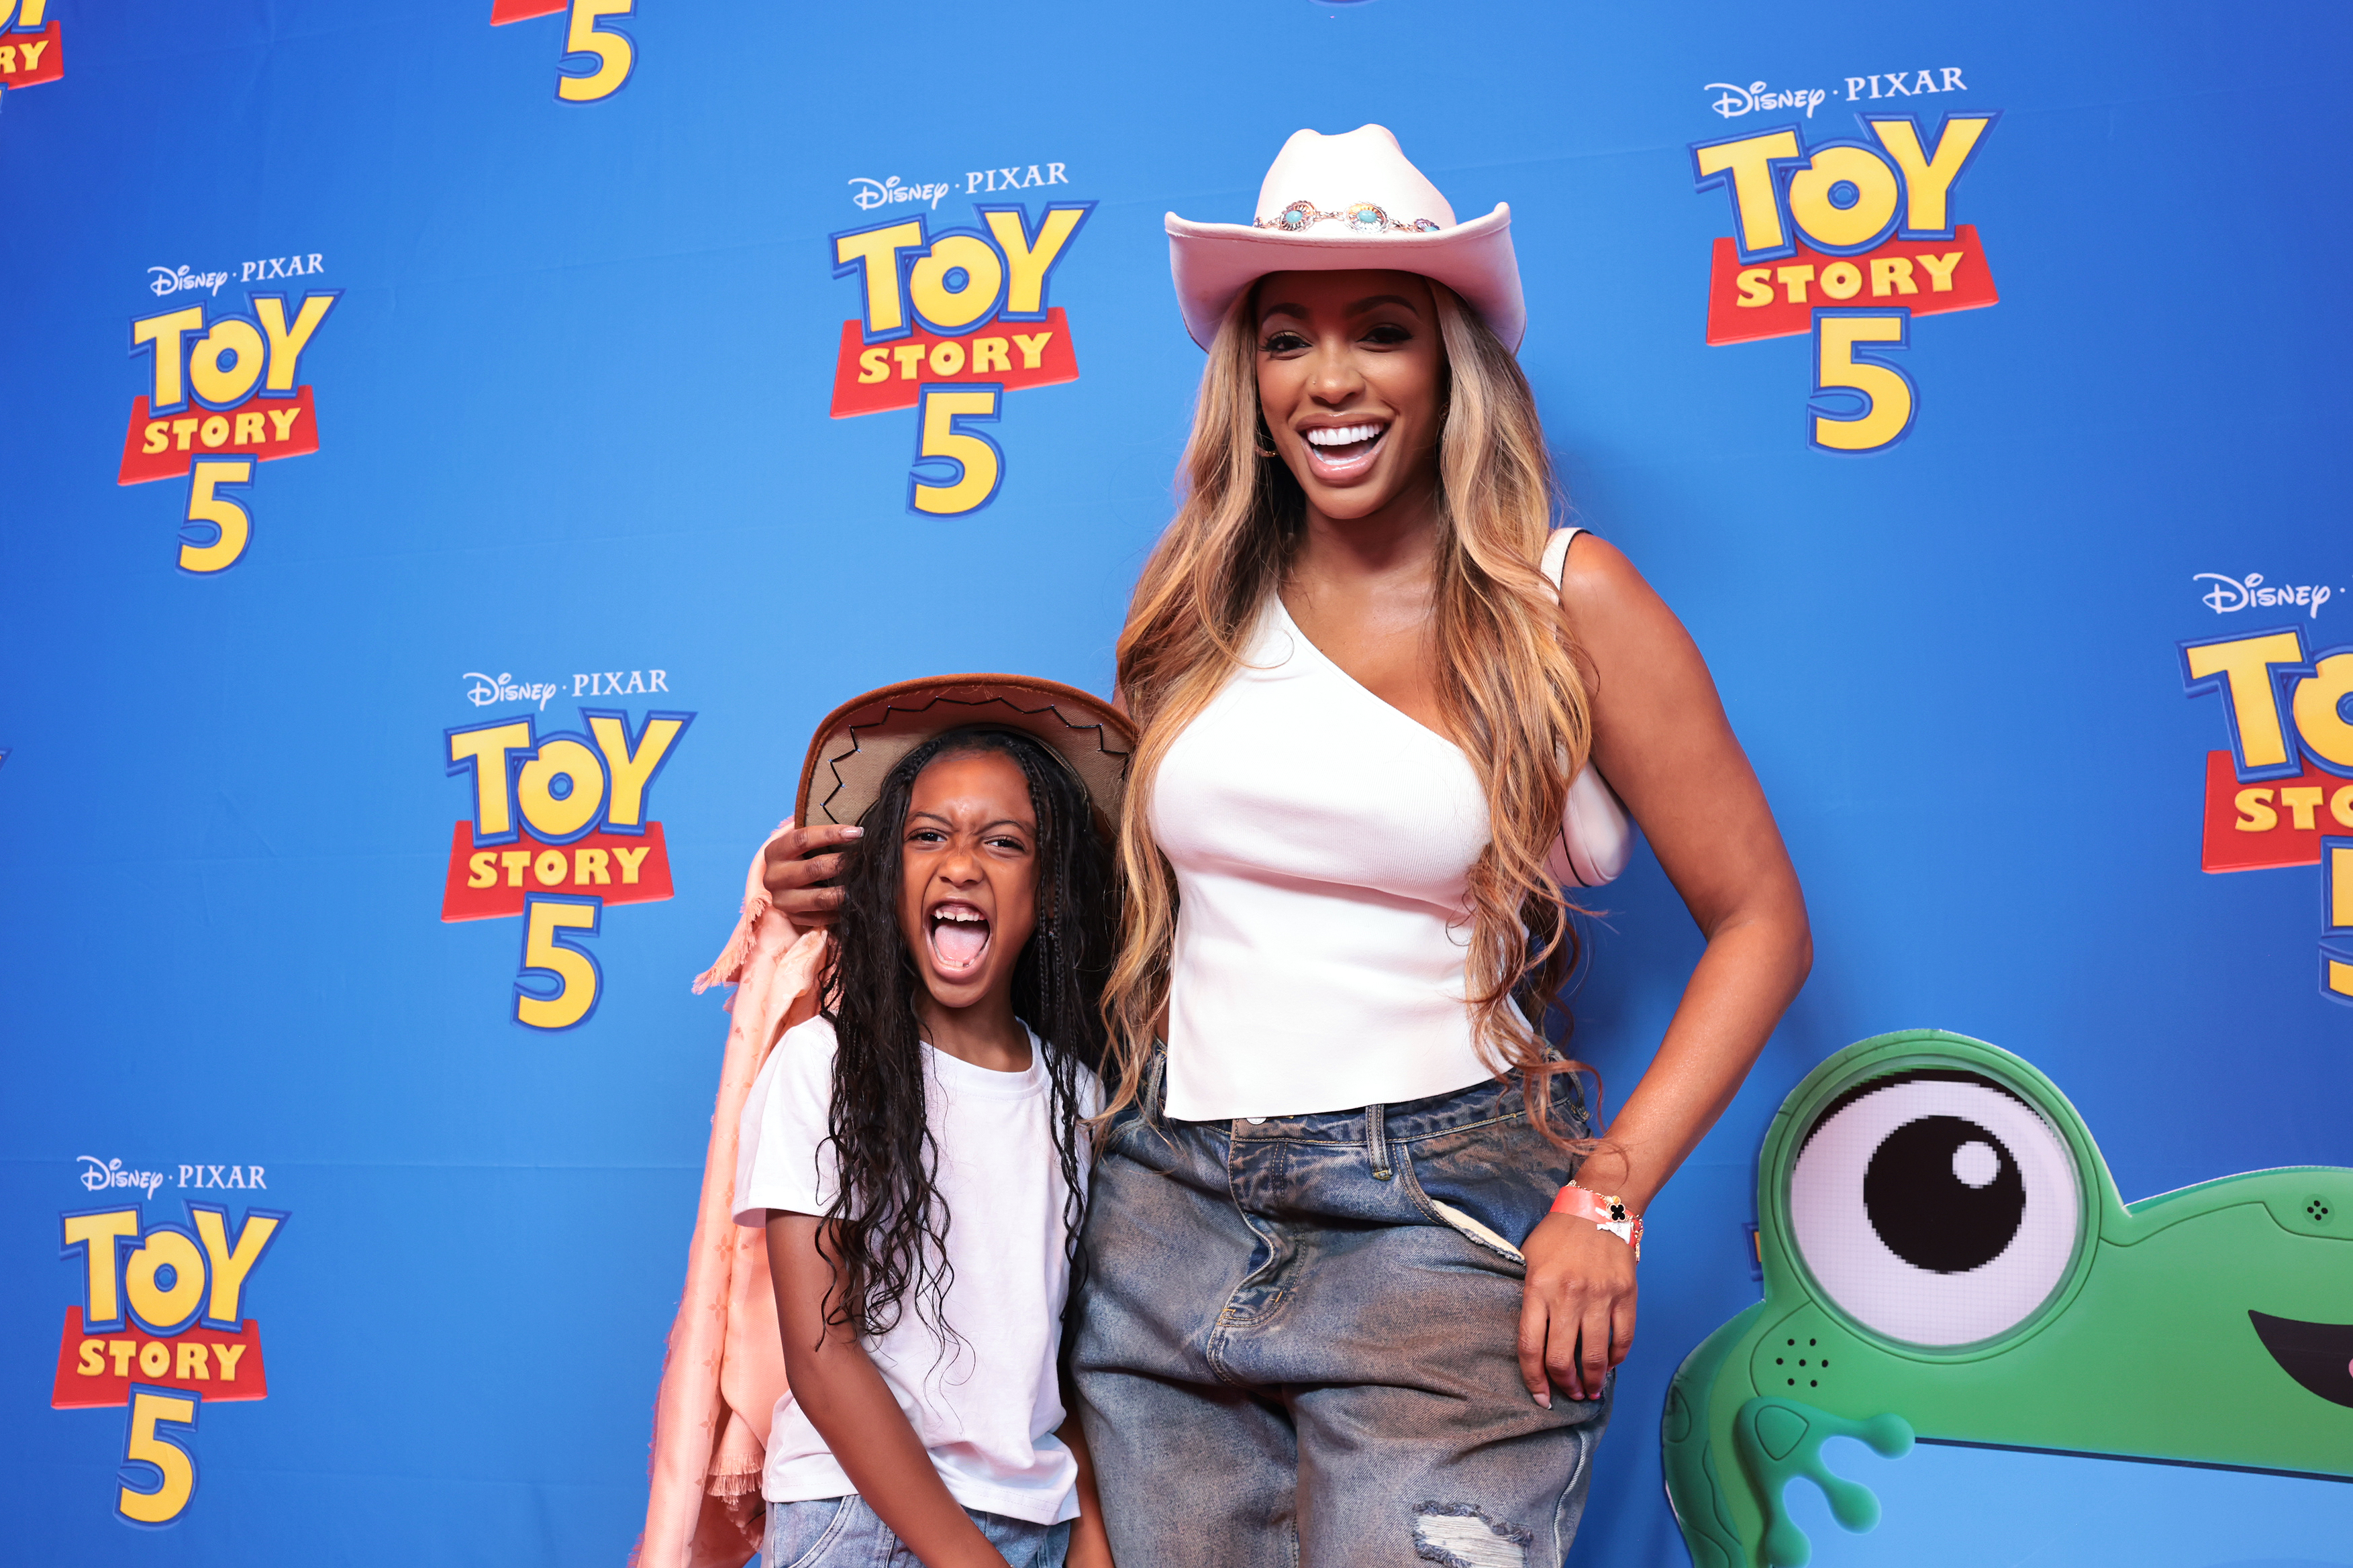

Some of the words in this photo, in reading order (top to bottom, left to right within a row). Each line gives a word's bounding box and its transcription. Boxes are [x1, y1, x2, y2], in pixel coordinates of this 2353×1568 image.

[556, 0, 635, 104] 5
[1844, 67, 1968, 102] PIXAR
[965, 162, 1069, 195] PIXAR
[1694, 115, 1992, 254] TOY
[241, 253, 325, 284] PIXAR
[834, 206, 1087, 335] TOY
[1736, 251, 1964, 309] STORY
[131, 293, 338, 410] TOY
[858, 331, 1053, 384] STORY
[1813, 314, 1914, 453] 5
[142, 407, 301, 454] STORY
[911, 389, 1001, 517] 5
[177, 459, 254, 575] 5
[572, 669, 669, 697] PIXAR
[448, 715, 685, 838] TOY
[467, 846, 651, 888] STORY
[515, 899, 599, 1031] 5
[177, 1164, 267, 1190] PIXAR
[62, 1207, 281, 1330] TOY
[77, 1339, 247, 1381] STORY
[117, 1390, 197, 1526] 5
